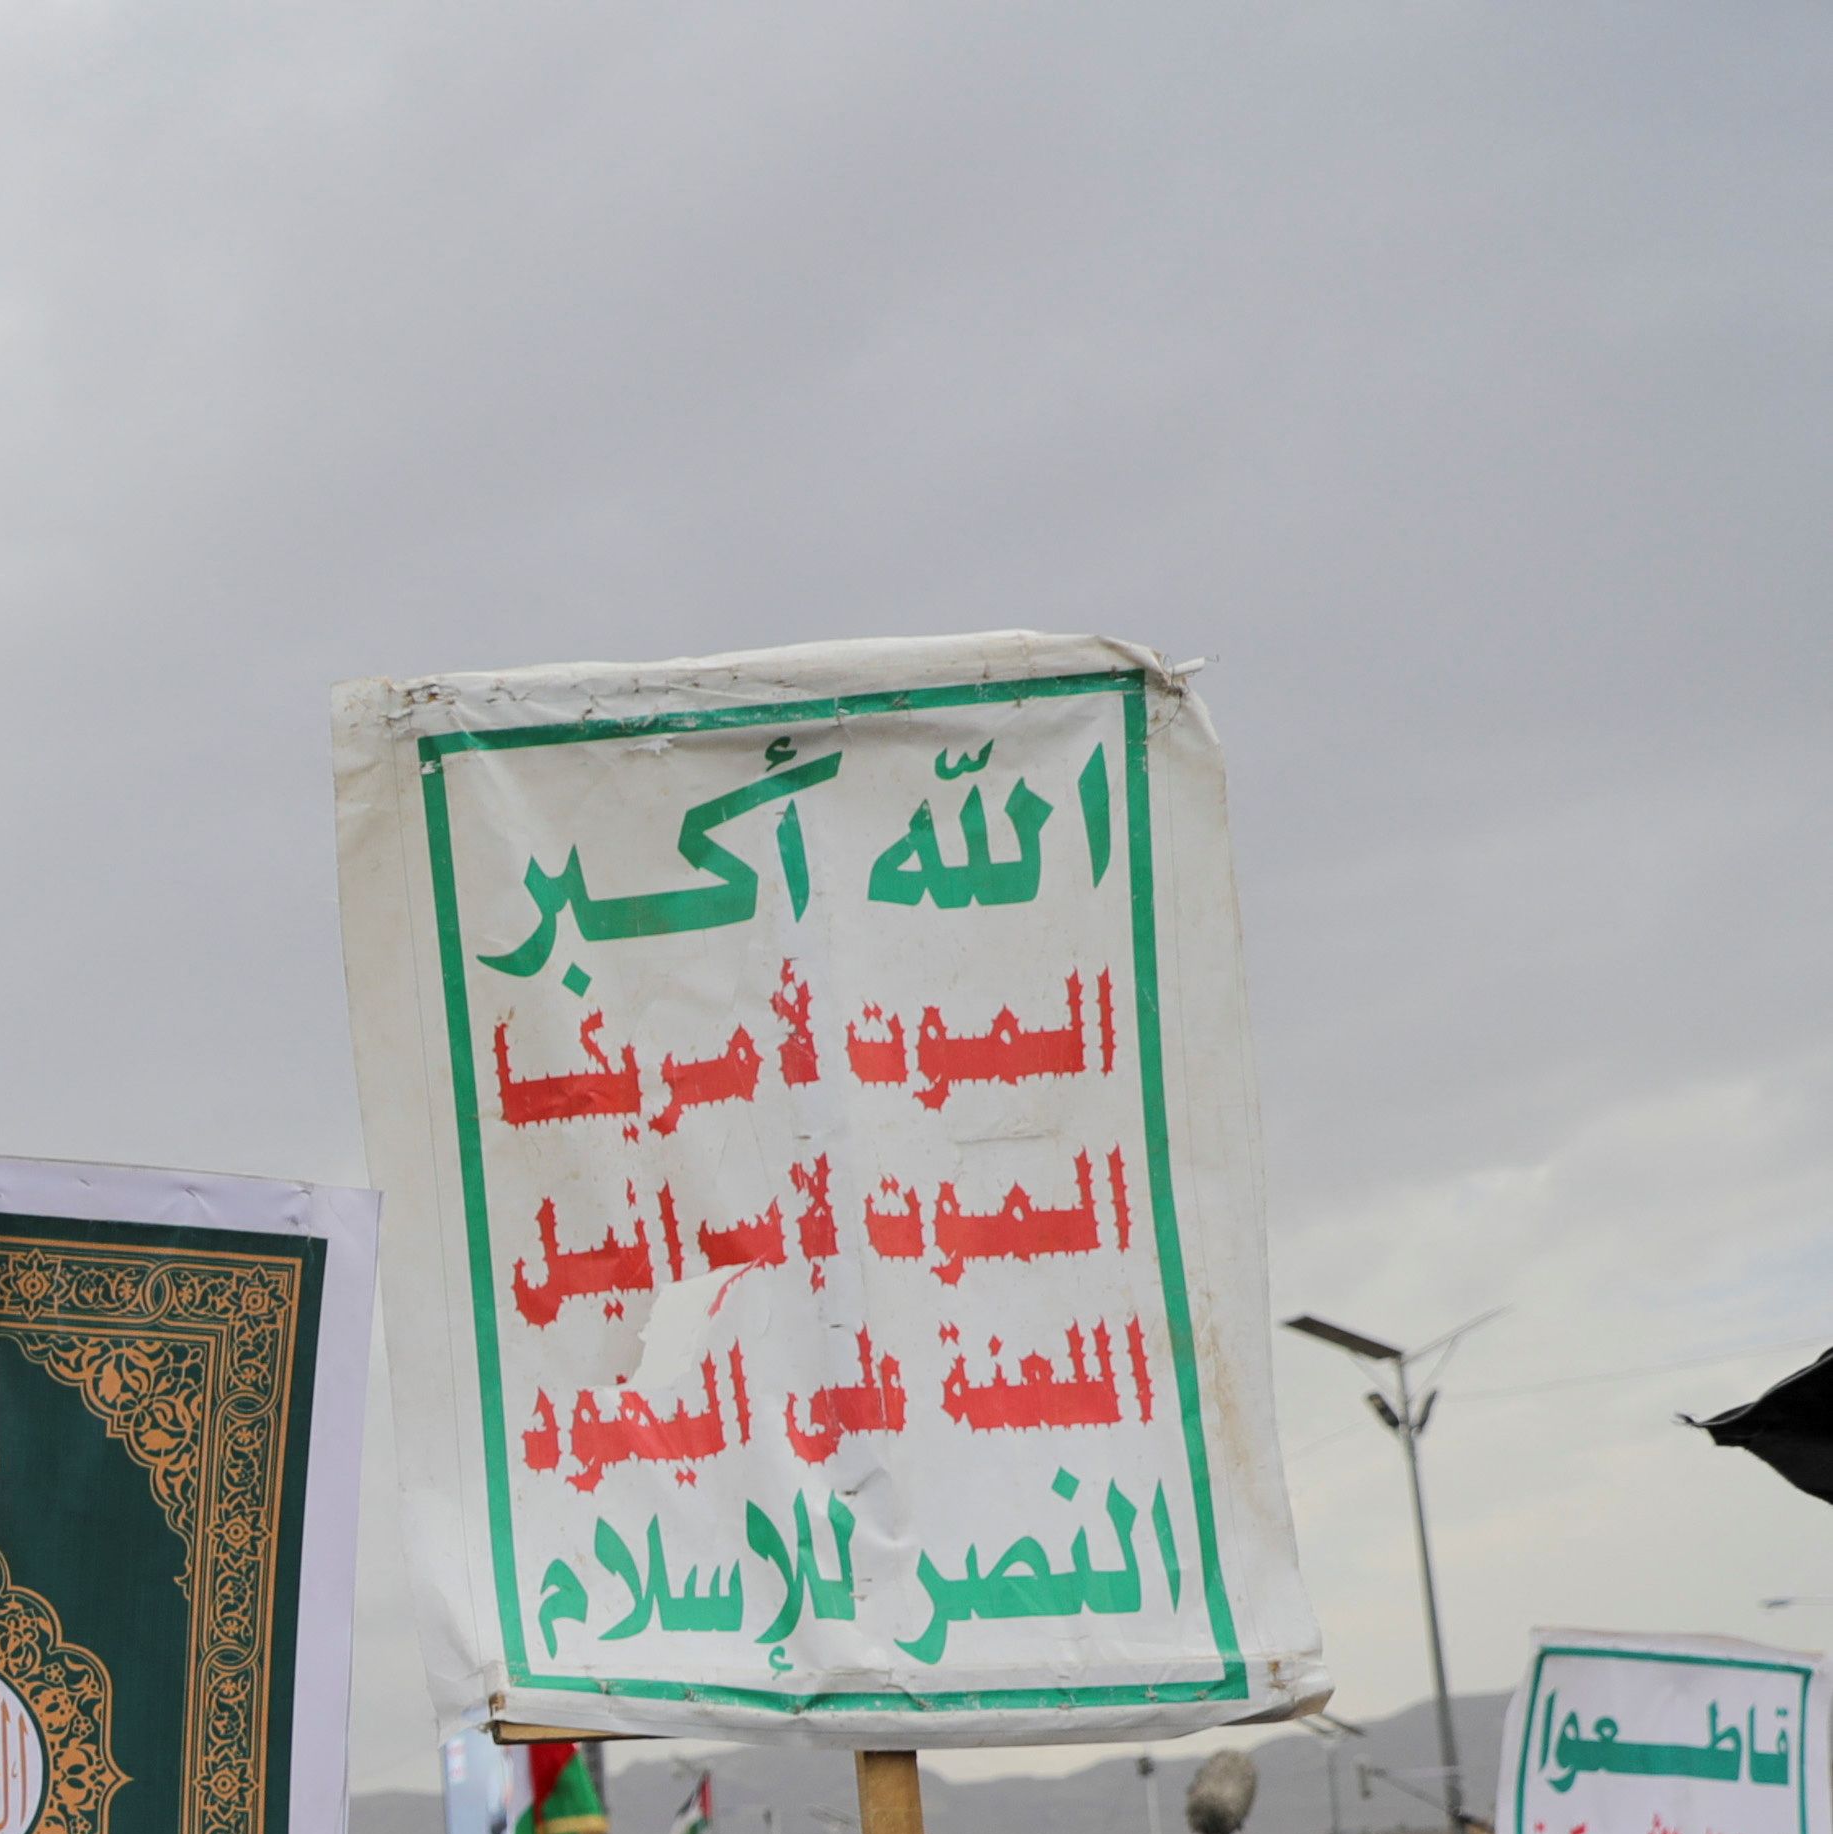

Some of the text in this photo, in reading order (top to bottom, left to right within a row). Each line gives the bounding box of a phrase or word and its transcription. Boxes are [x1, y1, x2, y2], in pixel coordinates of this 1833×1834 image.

[475, 734, 1115, 997] الله أكبر
[491, 957, 1117, 1142] الموت لأمريكا
[864, 1140, 1133, 1286] الموت
[520, 1315, 1155, 1493] اللعنة على اليهود
[536, 1467, 1182, 1673] النصر للإسلام
[1537, 1689, 1790, 1793] قاطعوا
